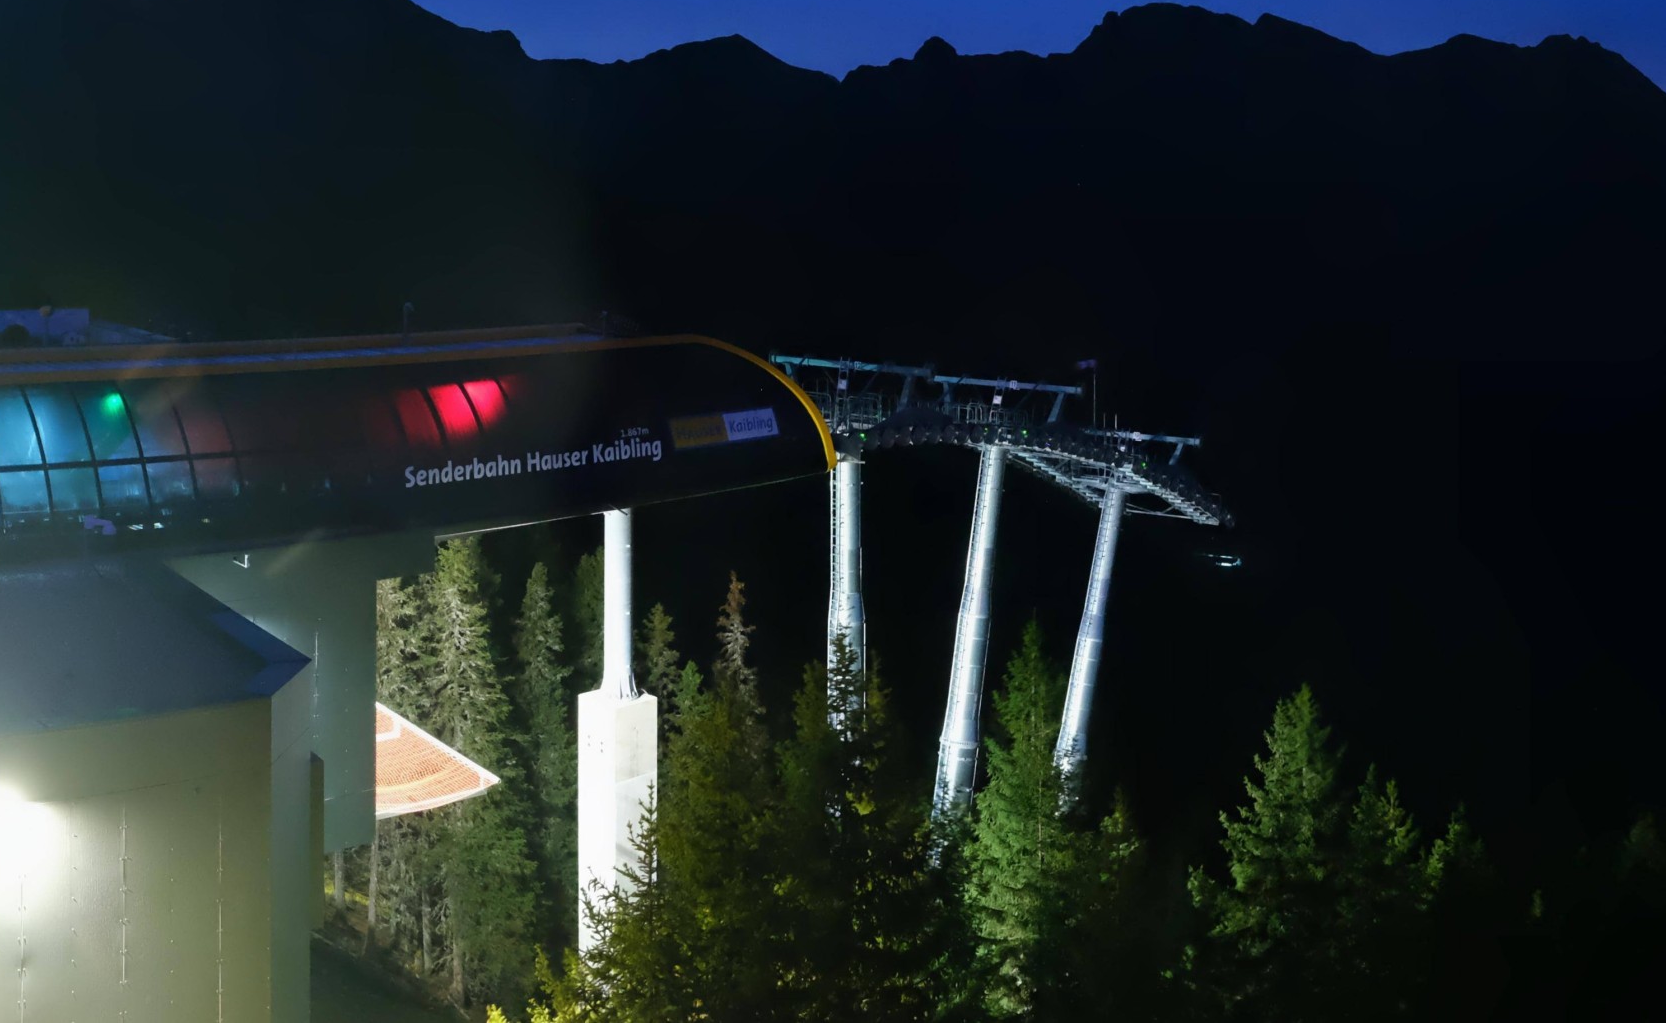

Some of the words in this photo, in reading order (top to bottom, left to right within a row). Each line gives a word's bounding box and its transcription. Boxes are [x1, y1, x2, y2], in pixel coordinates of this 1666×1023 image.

[729, 417, 773, 434] Kaibling
[404, 454, 522, 488] Senderbahn
[526, 449, 589, 473] Hauser
[592, 437, 663, 464] Kaibling
